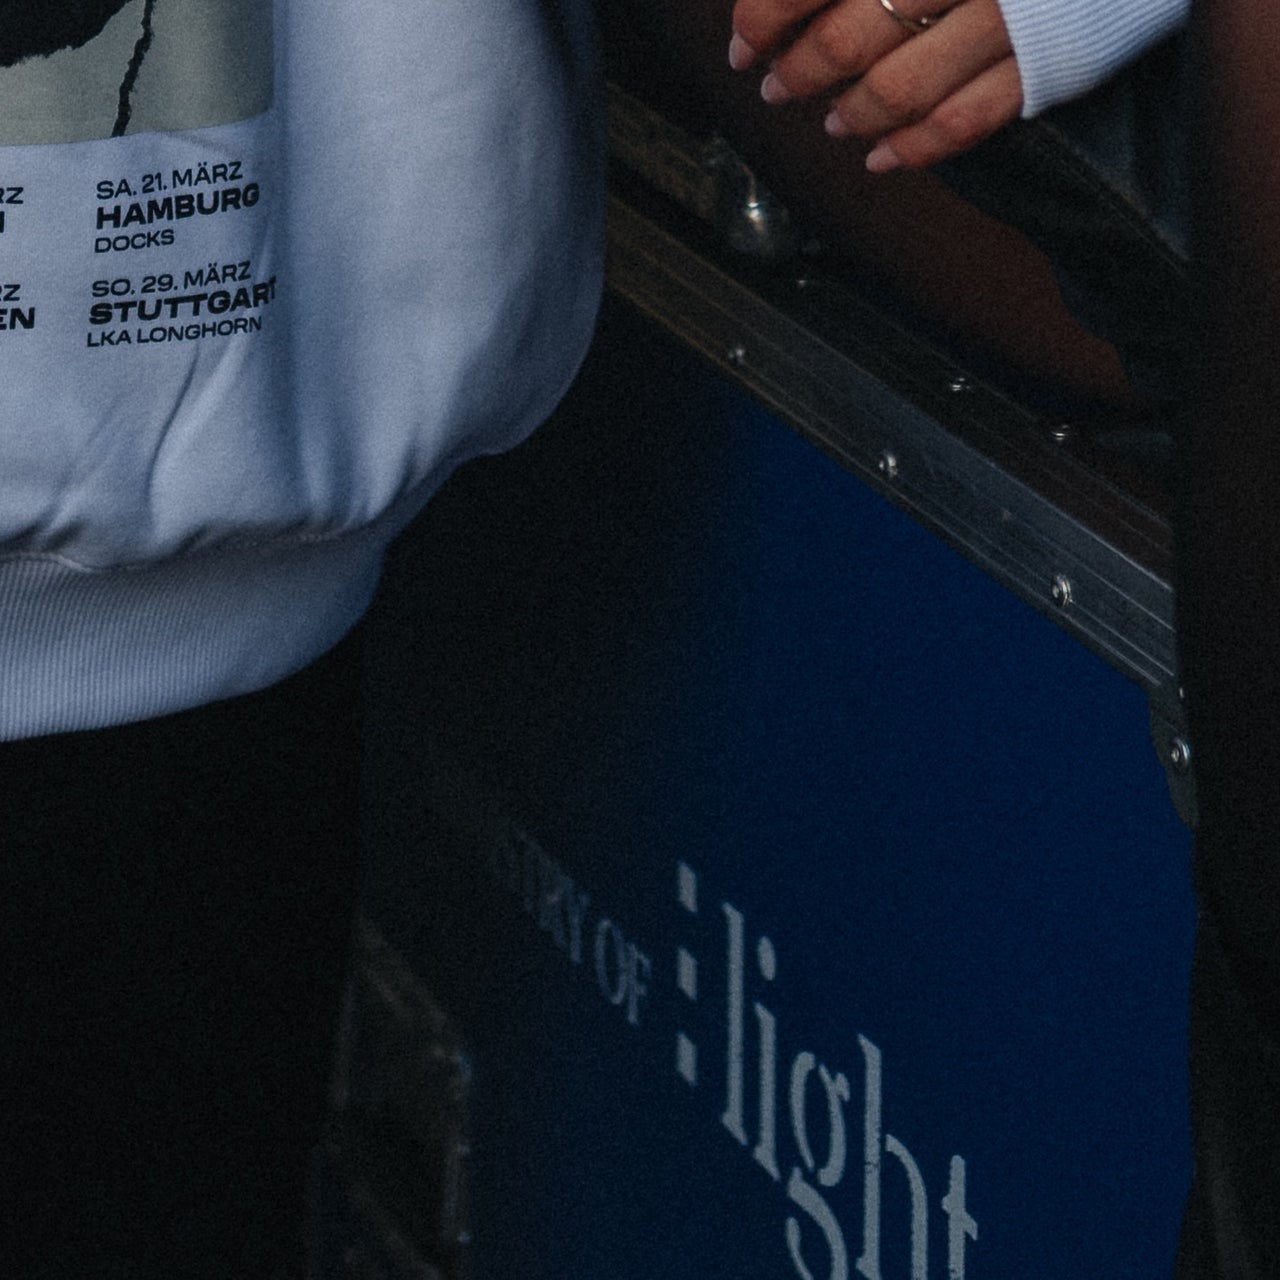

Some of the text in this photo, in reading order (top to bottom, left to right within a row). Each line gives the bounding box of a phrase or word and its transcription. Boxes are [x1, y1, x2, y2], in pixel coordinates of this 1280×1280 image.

[96, 161, 242, 200] SA. 21. MÄRZ
[96, 182, 260, 229] HAMBURG
[94, 229, 174, 254] DOCKS
[92, 260, 251, 298] SO. 29. MÄRZ
[87, 316, 262, 347] LKA LONGHORN
